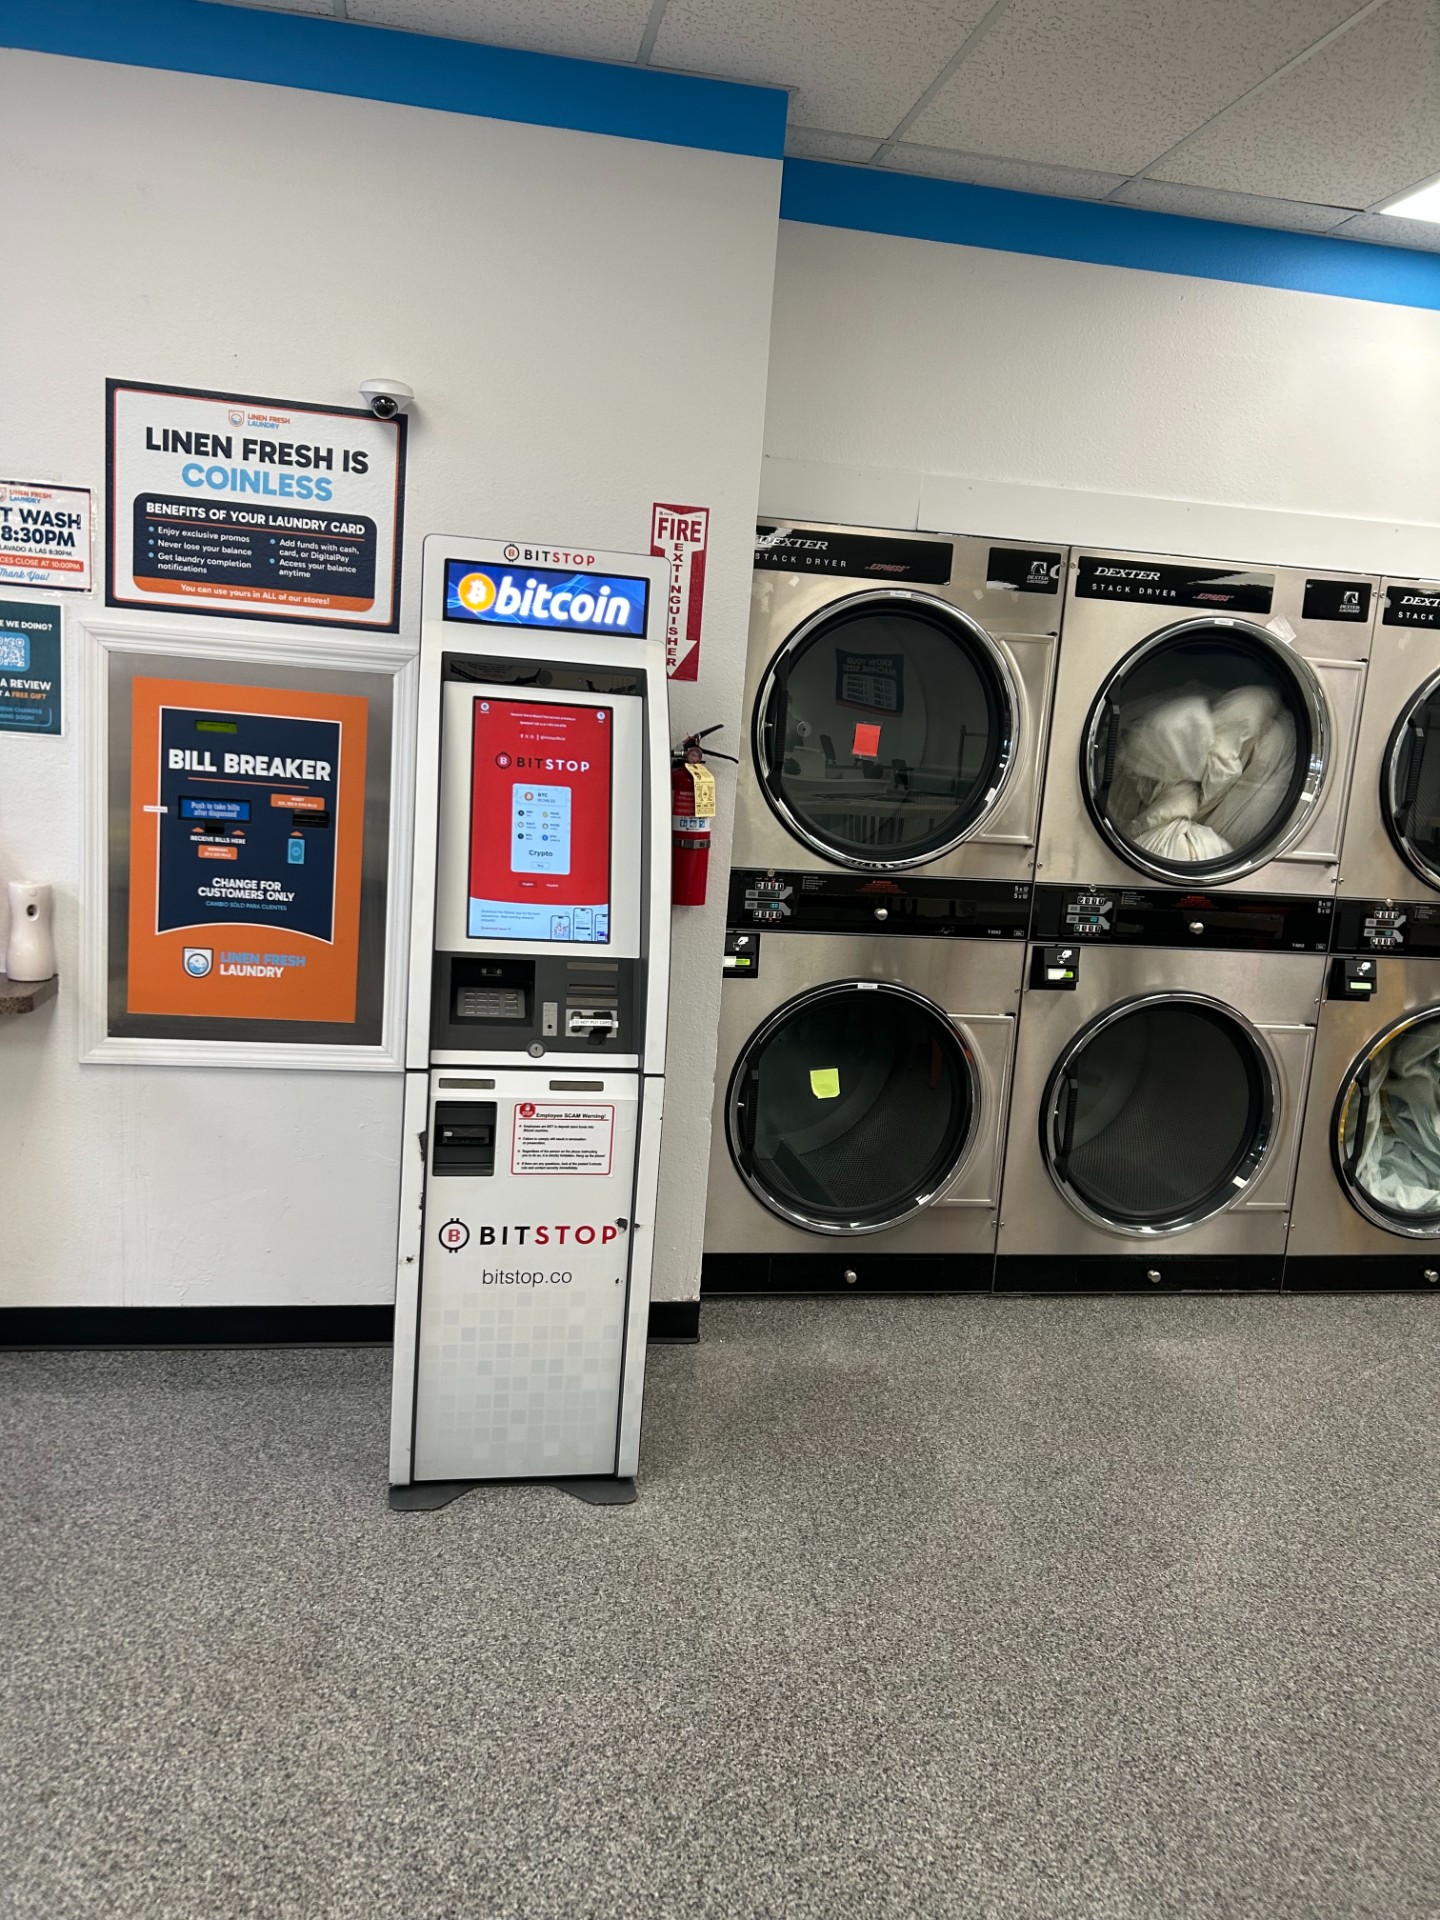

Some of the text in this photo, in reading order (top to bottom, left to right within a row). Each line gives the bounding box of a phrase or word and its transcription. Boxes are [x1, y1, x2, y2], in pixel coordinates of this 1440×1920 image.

[269, 415, 290, 424] FRESH
[146, 427, 369, 474] LINEN FRESH IS
[182, 463, 333, 501] COINLESS
[146, 502, 365, 534] BENEFITS OF YOUR LAUNDRY CARD
[1, 525, 75, 547] 8:30PM
[158, 526, 250, 542] Enjoy exclusive promos
[658, 517, 702, 542] FIRE
[158, 540, 181, 549] Never
[222, 546, 252, 556] balance
[297, 540, 318, 550] funds
[340, 546, 359, 554] cash,
[759, 535, 828, 550] DEXTER
[16, 557, 39, 566] CLOSE
[175, 554, 205, 564] laundry
[207, 558, 252, 568] completion
[279, 550, 298, 558] card,
[311, 552, 349, 563] DigitalPay
[524, 546, 595, 566] BITSTOP
[755, 552, 846, 567] STACK DRYER
[158, 563, 207, 574] notifications
[279, 559, 356, 573] Access your balance
[279, 569, 311, 578] anytime
[1094, 567, 1161, 580] DEXTER
[181, 584, 196, 592] You
[304, 596, 330, 605] stores!
[1092, 583, 1176, 597] STACK DRYER
[494, 576, 630, 625] bitcoin
[666, 543, 684, 666] EXTINGUISHER
[1398, 611, 1434, 620] STACK
[21, 622, 52, 631] DOING?
[0, 678, 51, 690] A REVIEW
[168, 749, 331, 781] BILL BREAKER
[517, 757, 590, 772] BITSTOP
[212, 877, 281, 891] CHANGE FOR
[198, 887, 295, 901] CUSTOMERS ONLY
[221, 952, 306, 967] LINEN FRESH
[219, 964, 284, 977] LAUNDRY
[480, 1226, 617, 1245] BITSTOP
[482, 1269, 573, 1287] bitstop.co
